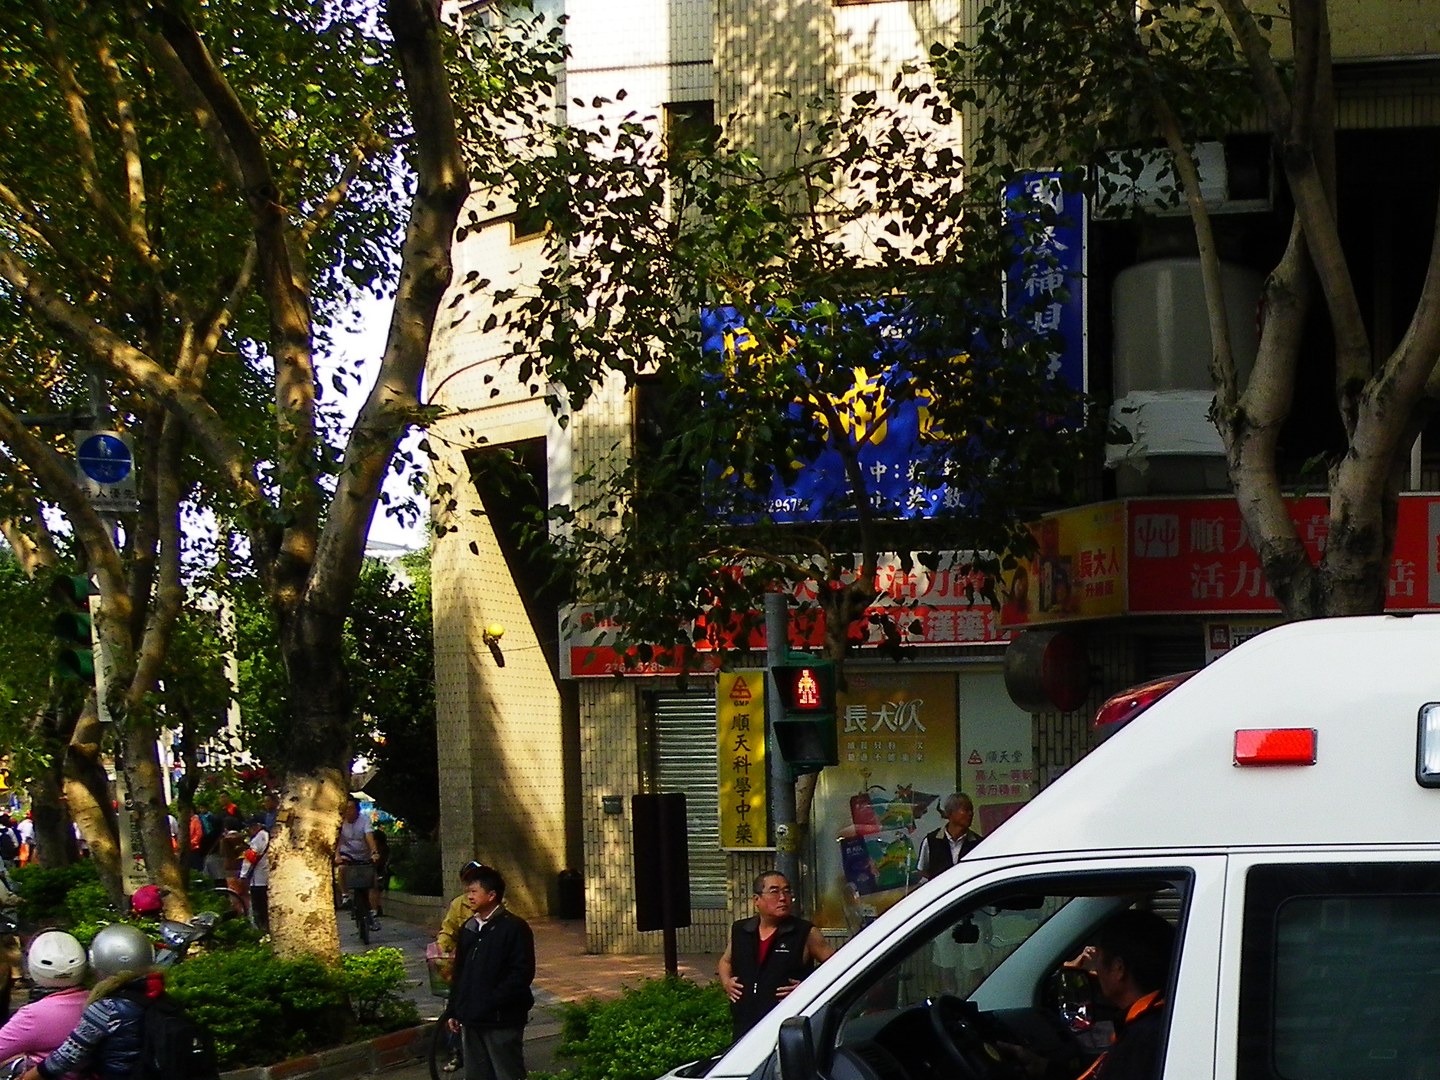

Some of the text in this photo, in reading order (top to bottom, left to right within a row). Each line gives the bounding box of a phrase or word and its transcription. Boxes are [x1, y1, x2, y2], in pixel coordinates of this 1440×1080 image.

[731, 711, 753, 846] 順天科學中藥
